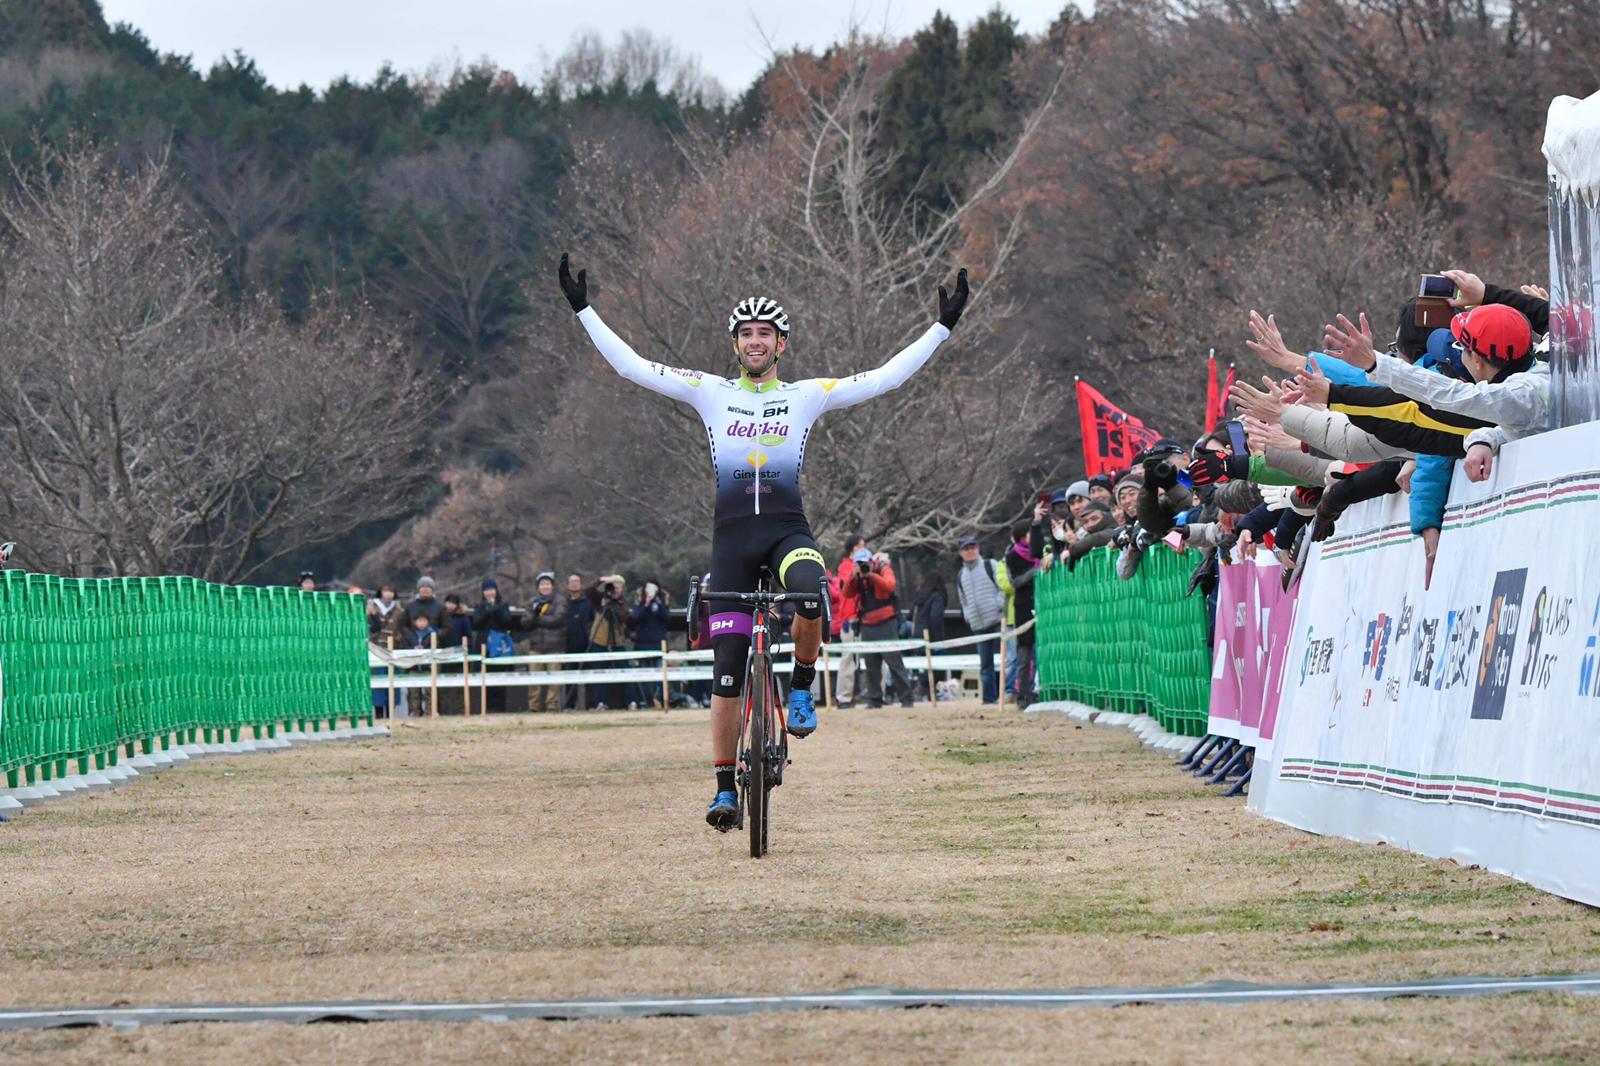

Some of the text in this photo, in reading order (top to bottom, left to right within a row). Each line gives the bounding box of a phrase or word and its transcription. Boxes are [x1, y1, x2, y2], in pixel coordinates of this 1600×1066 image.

[763, 406, 789, 418] BH
[733, 469, 781, 480] Ginestar
[711, 619, 734, 631] BH
